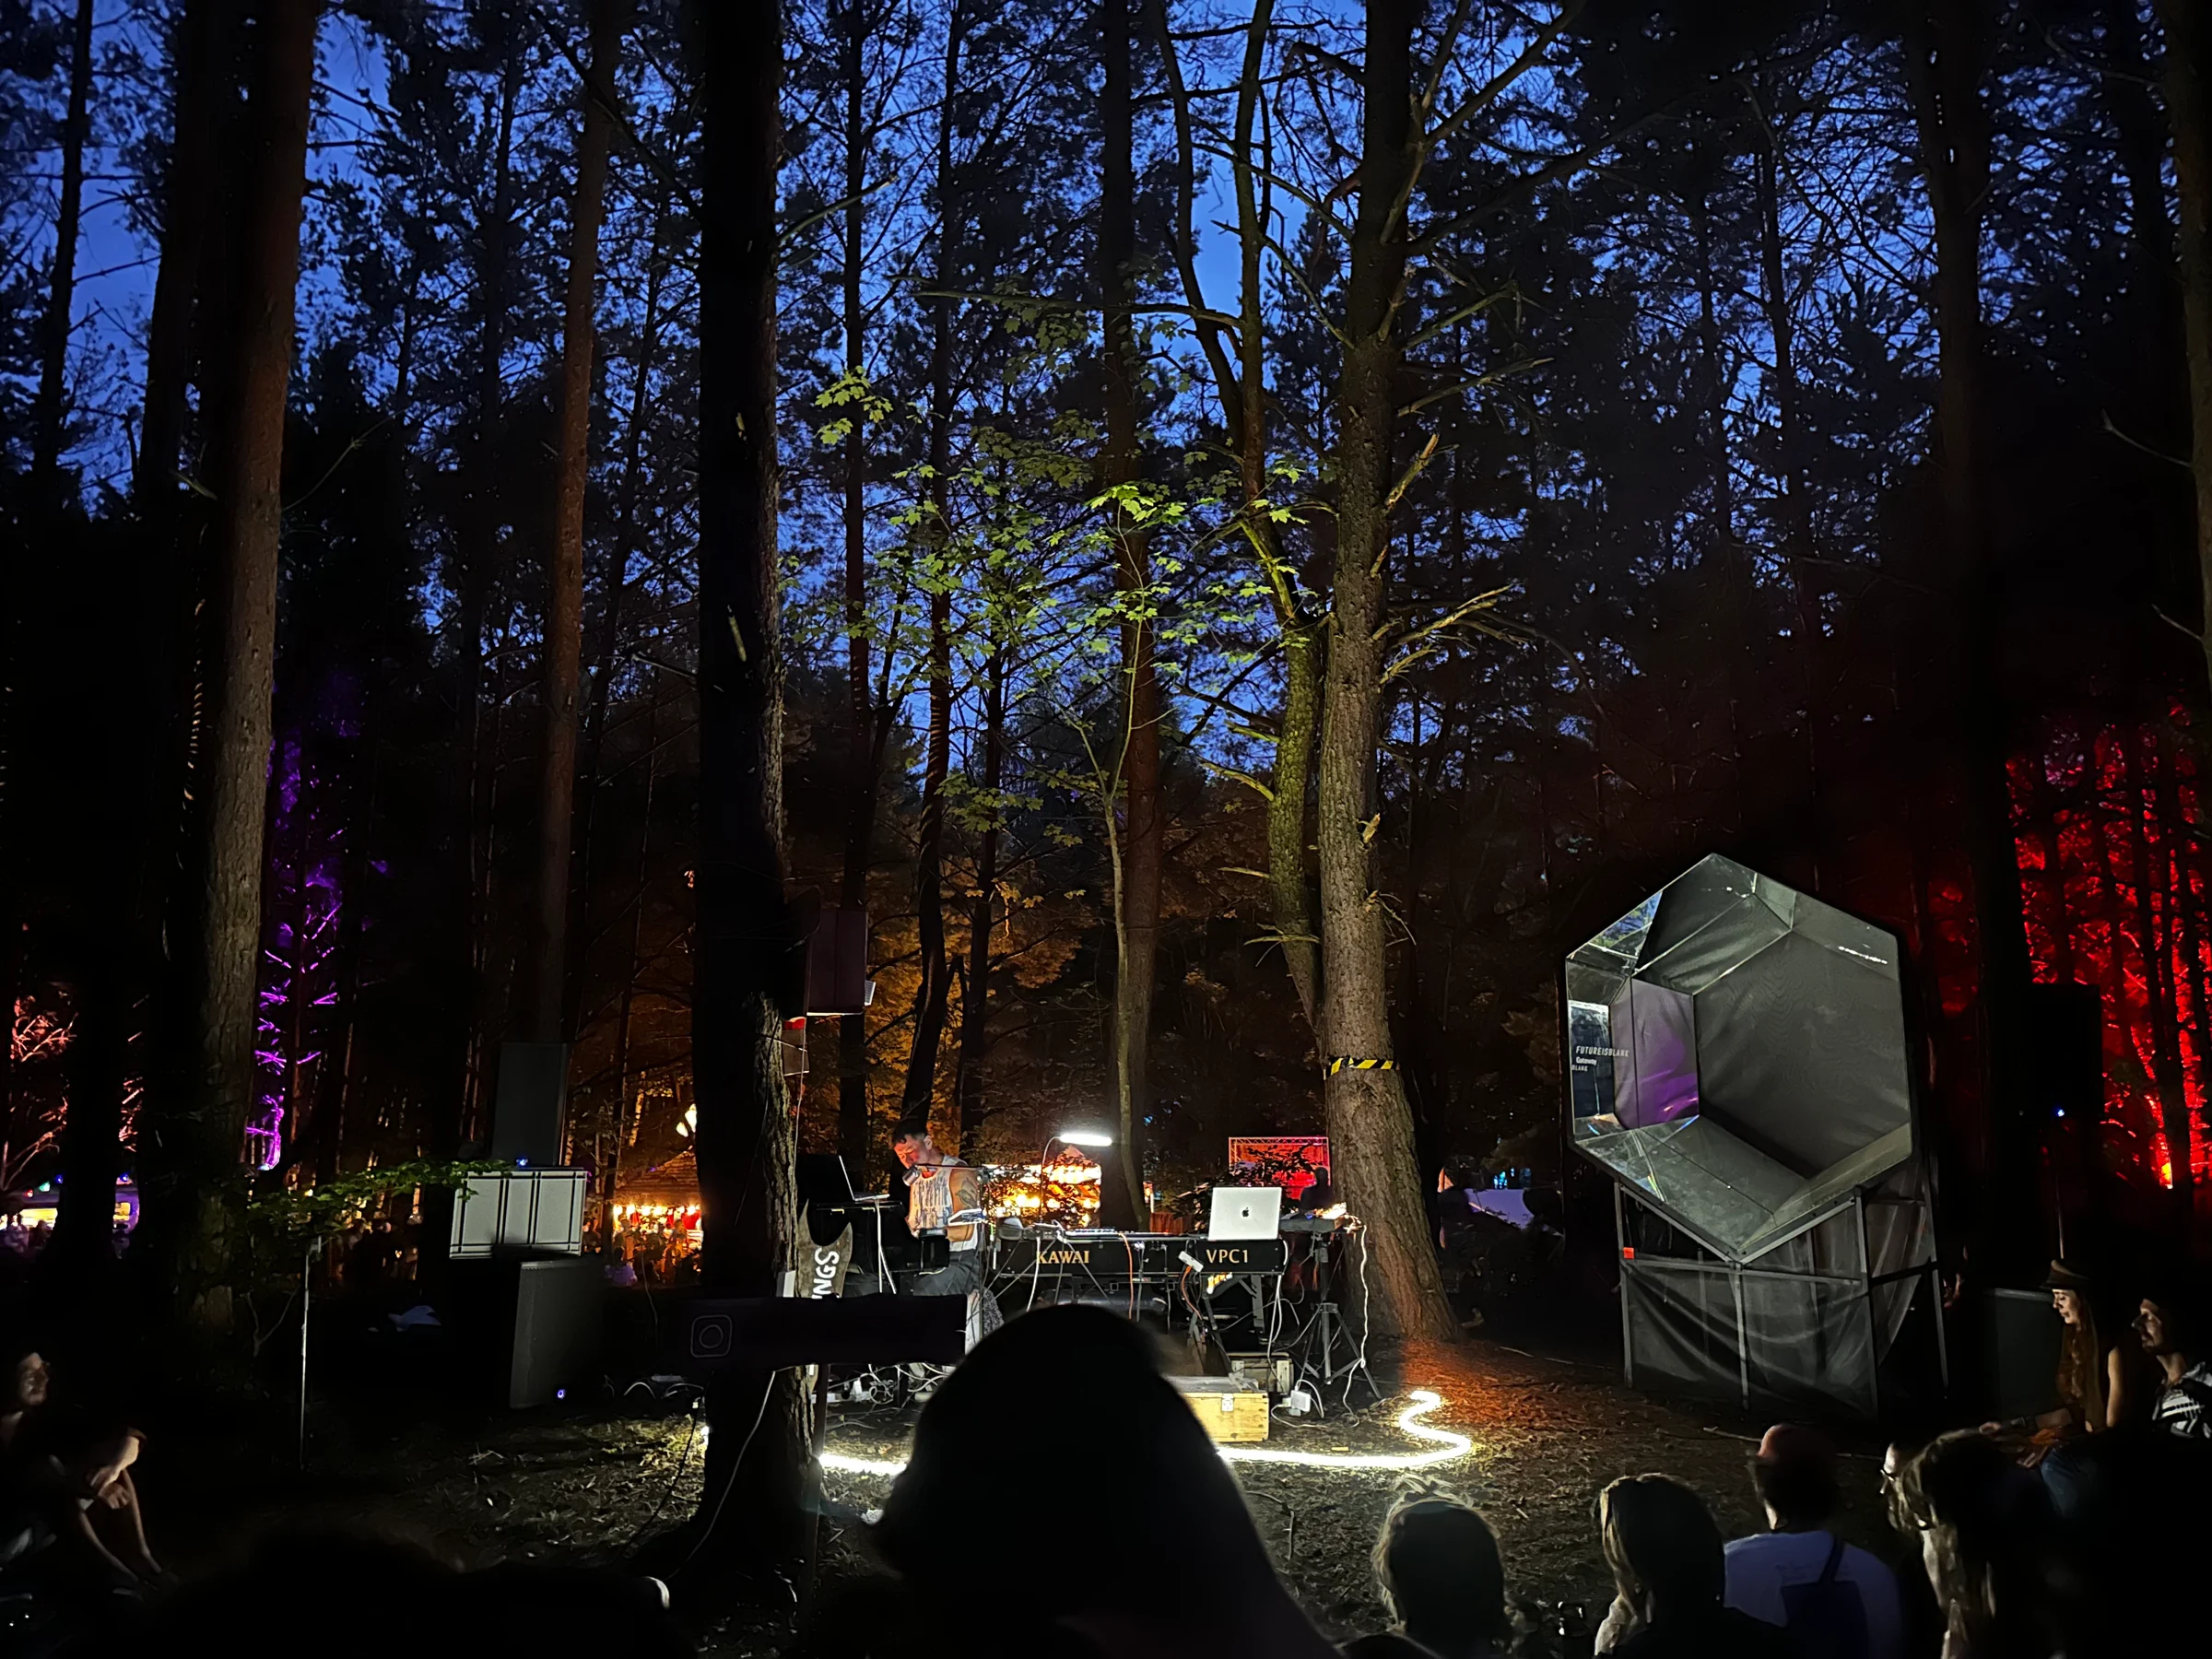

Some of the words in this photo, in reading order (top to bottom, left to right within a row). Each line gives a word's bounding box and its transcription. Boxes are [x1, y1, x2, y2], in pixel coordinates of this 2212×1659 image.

[1575, 1045, 1630, 1057] FUTUREISBLANK
[1036, 1250, 1089, 1265] KAWAI
[1206, 1248, 1249, 1264] VPC1
